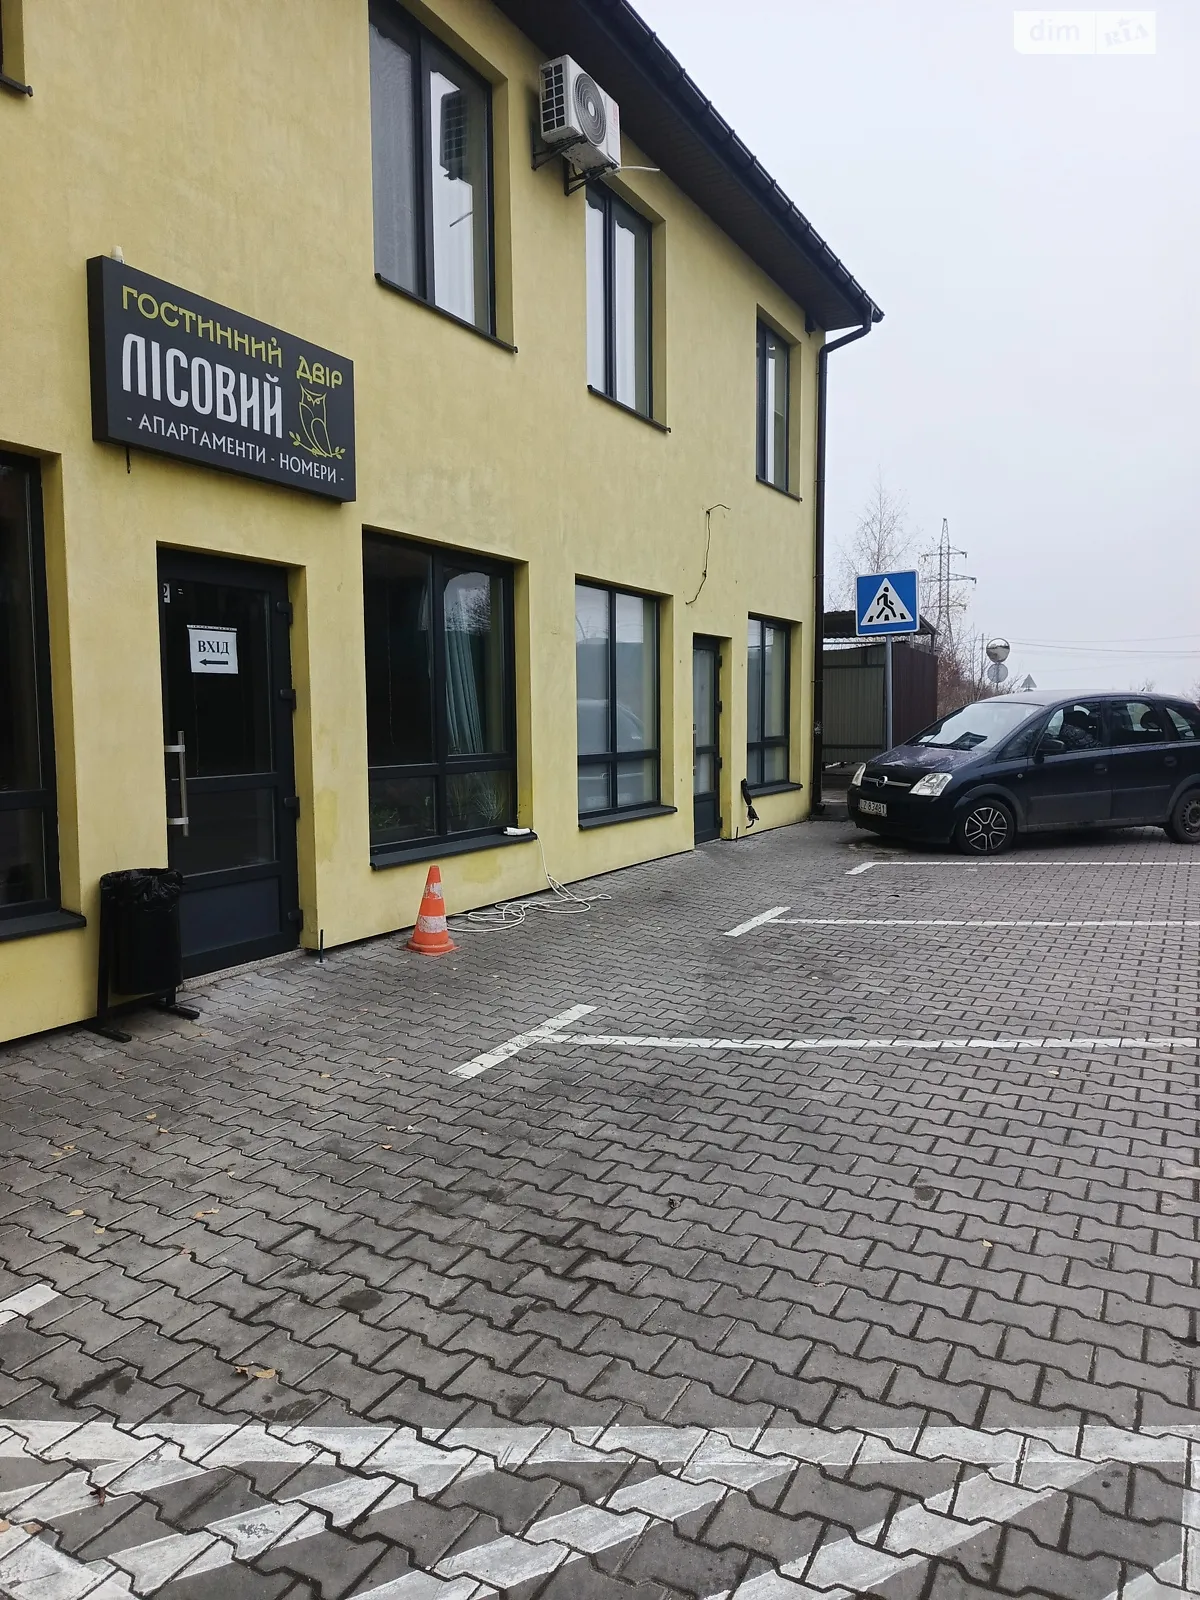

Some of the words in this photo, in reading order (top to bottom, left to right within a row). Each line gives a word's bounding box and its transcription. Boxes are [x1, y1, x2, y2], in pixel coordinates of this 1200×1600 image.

[122, 285, 283, 369] ГОСТИННИЙ
[296, 355, 343, 389] ДВІР
[122, 333, 283, 439] ЛІСОВИЙ
[138, 413, 266, 464] АПАРТАМЕНТИ
[279, 453, 337, 484] НОМЕРИ
[197, 640, 229, 655] ВХІД
